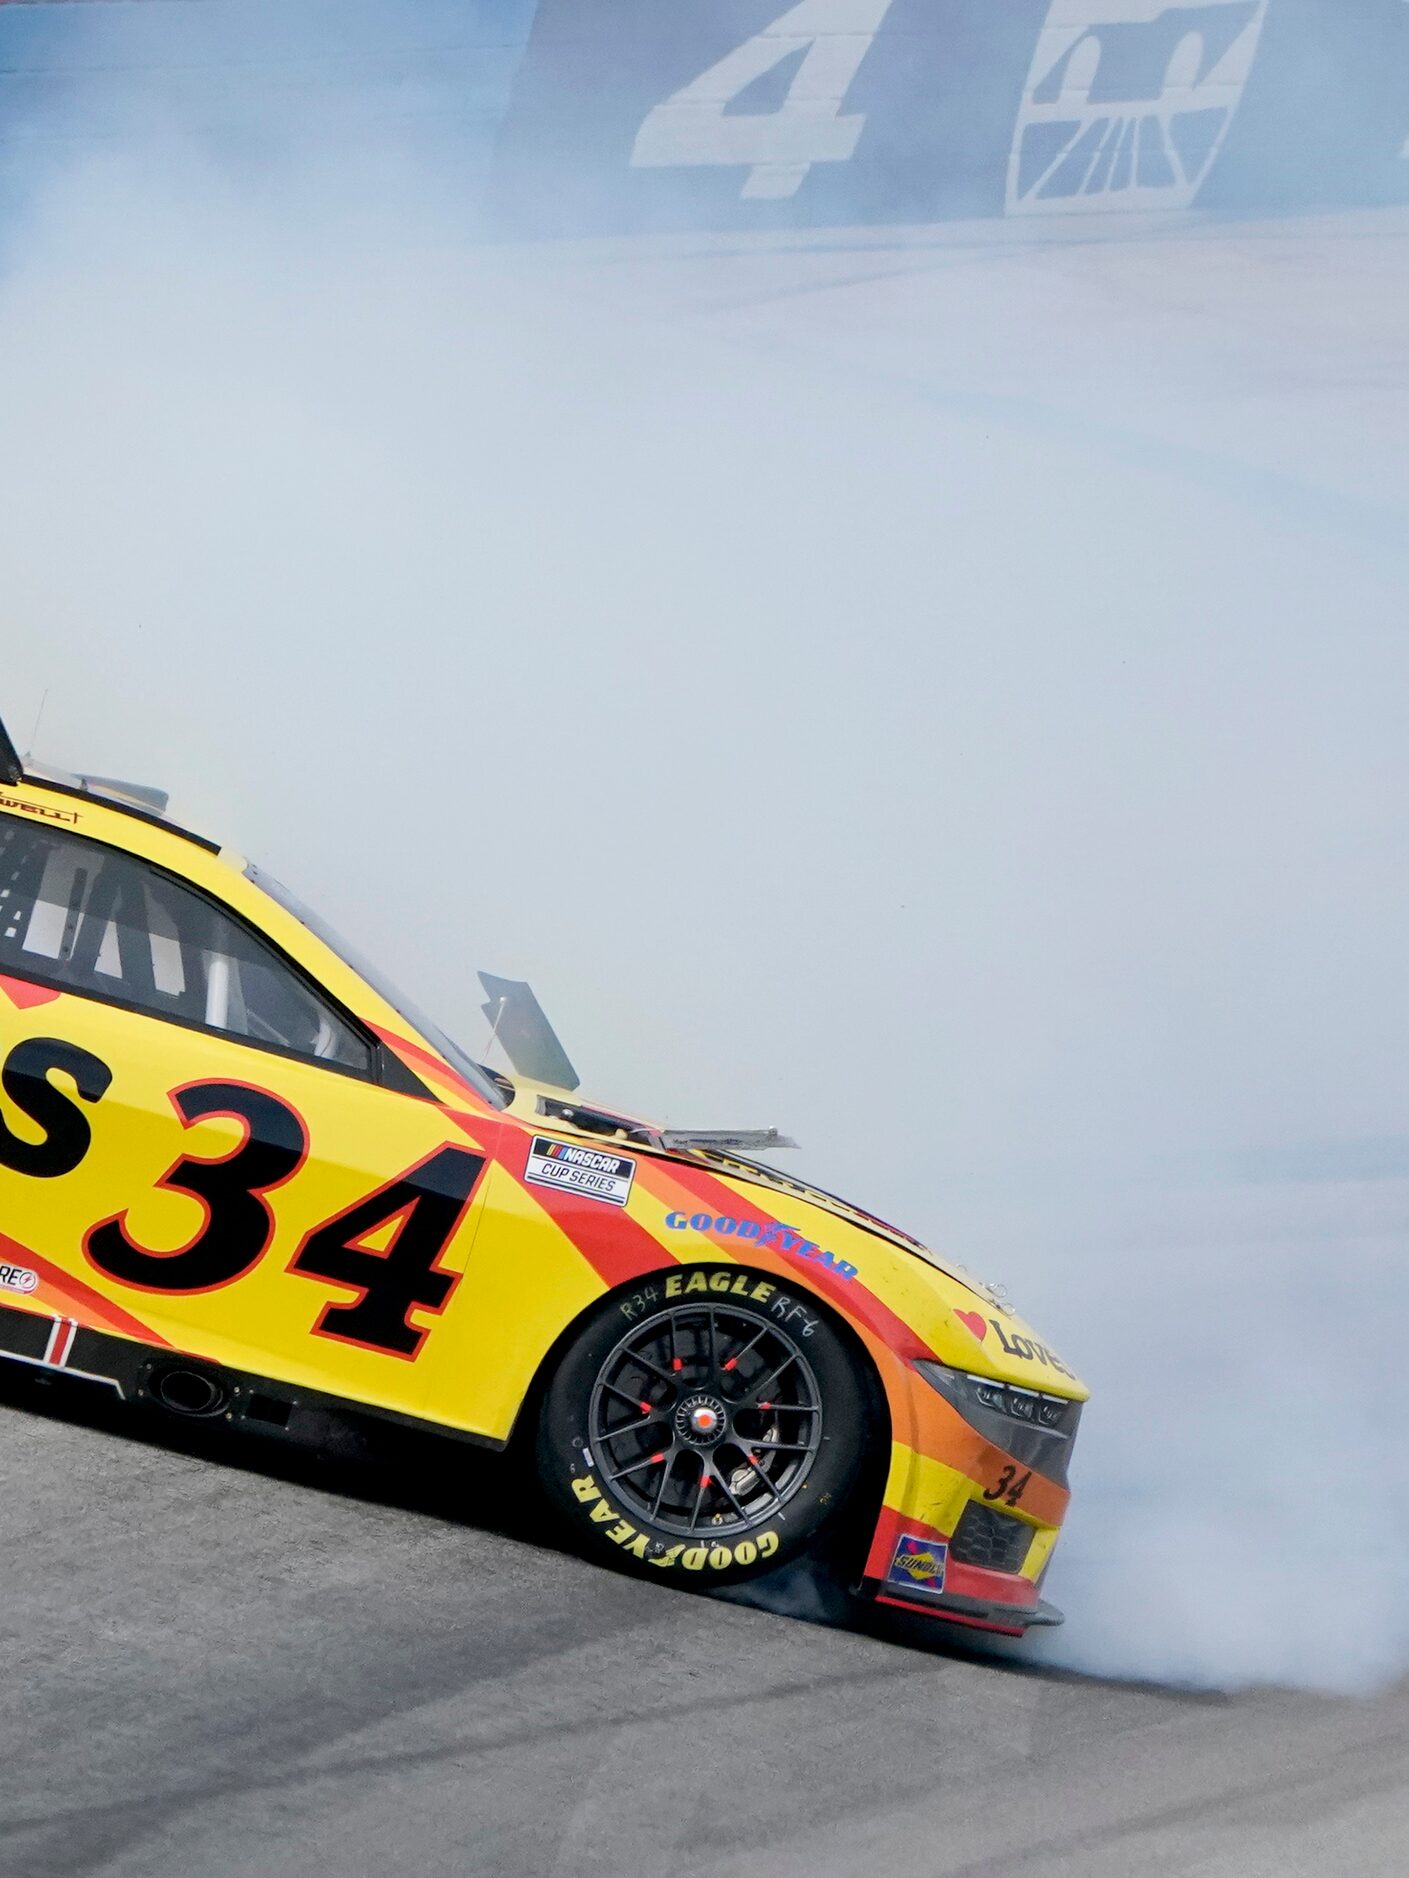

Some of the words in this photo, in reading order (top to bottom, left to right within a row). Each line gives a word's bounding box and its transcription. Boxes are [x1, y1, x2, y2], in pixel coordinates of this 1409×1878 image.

[630, 0, 892, 199] 4
[541, 1163, 569, 1178] CUP
[570, 1171, 616, 1192] SERIES
[562, 1147, 620, 1174] NASCAR
[83, 1077, 491, 1362] 34
[665, 1211, 858, 1281] GOODYEAR
[665, 1271, 776, 1303] EAGLE
[983, 1465, 1032, 1507] 34
[571, 1474, 779, 1571] GOODYEAR
